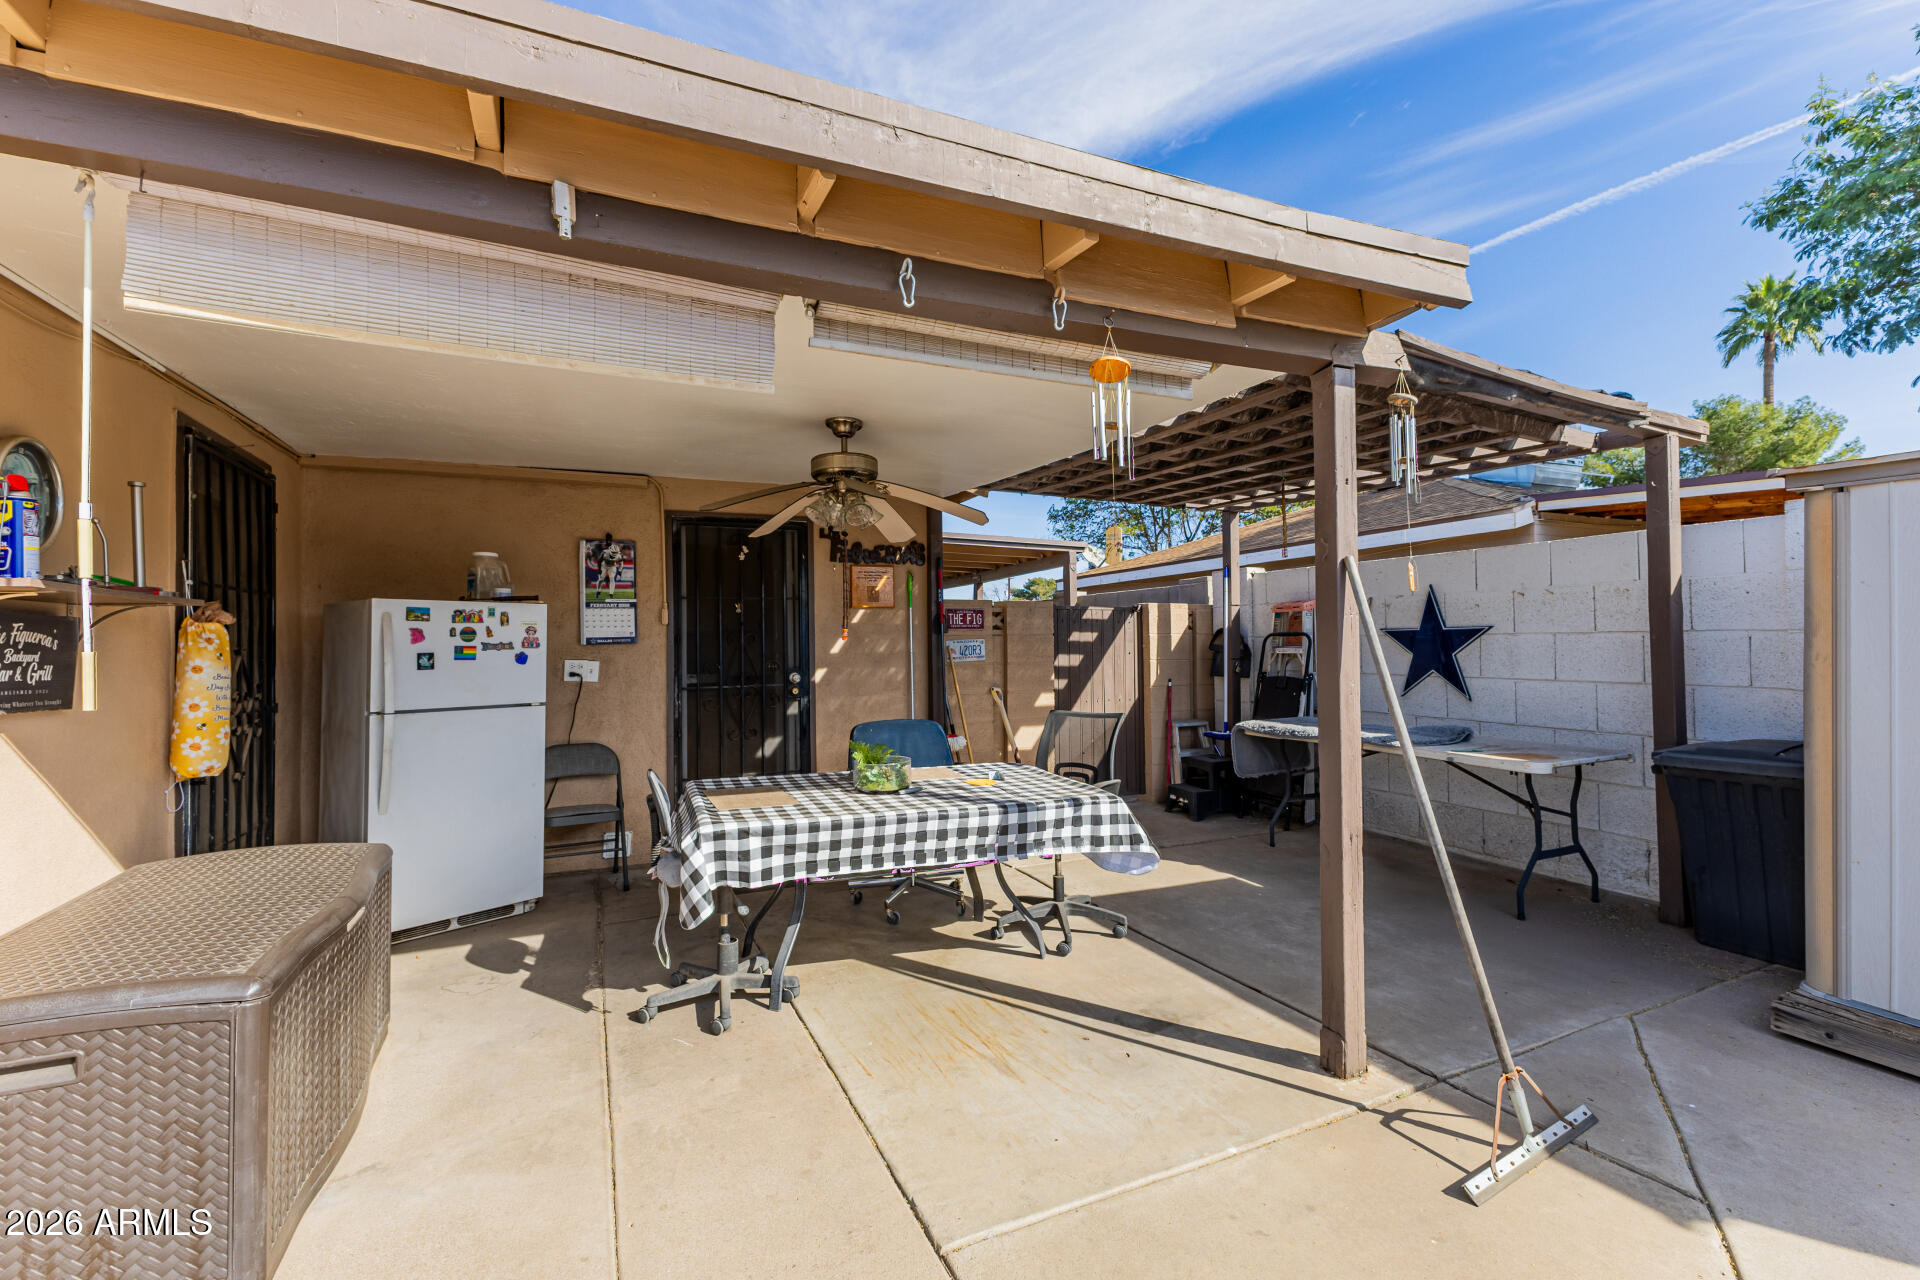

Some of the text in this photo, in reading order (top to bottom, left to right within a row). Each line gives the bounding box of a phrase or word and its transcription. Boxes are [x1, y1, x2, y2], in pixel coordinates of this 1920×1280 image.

[948, 613, 982, 624] THE FIG
[10, 622, 58, 650] Figueroa's
[4, 648, 41, 667] Backyard
[0, 662, 53, 686] ar & Grill
